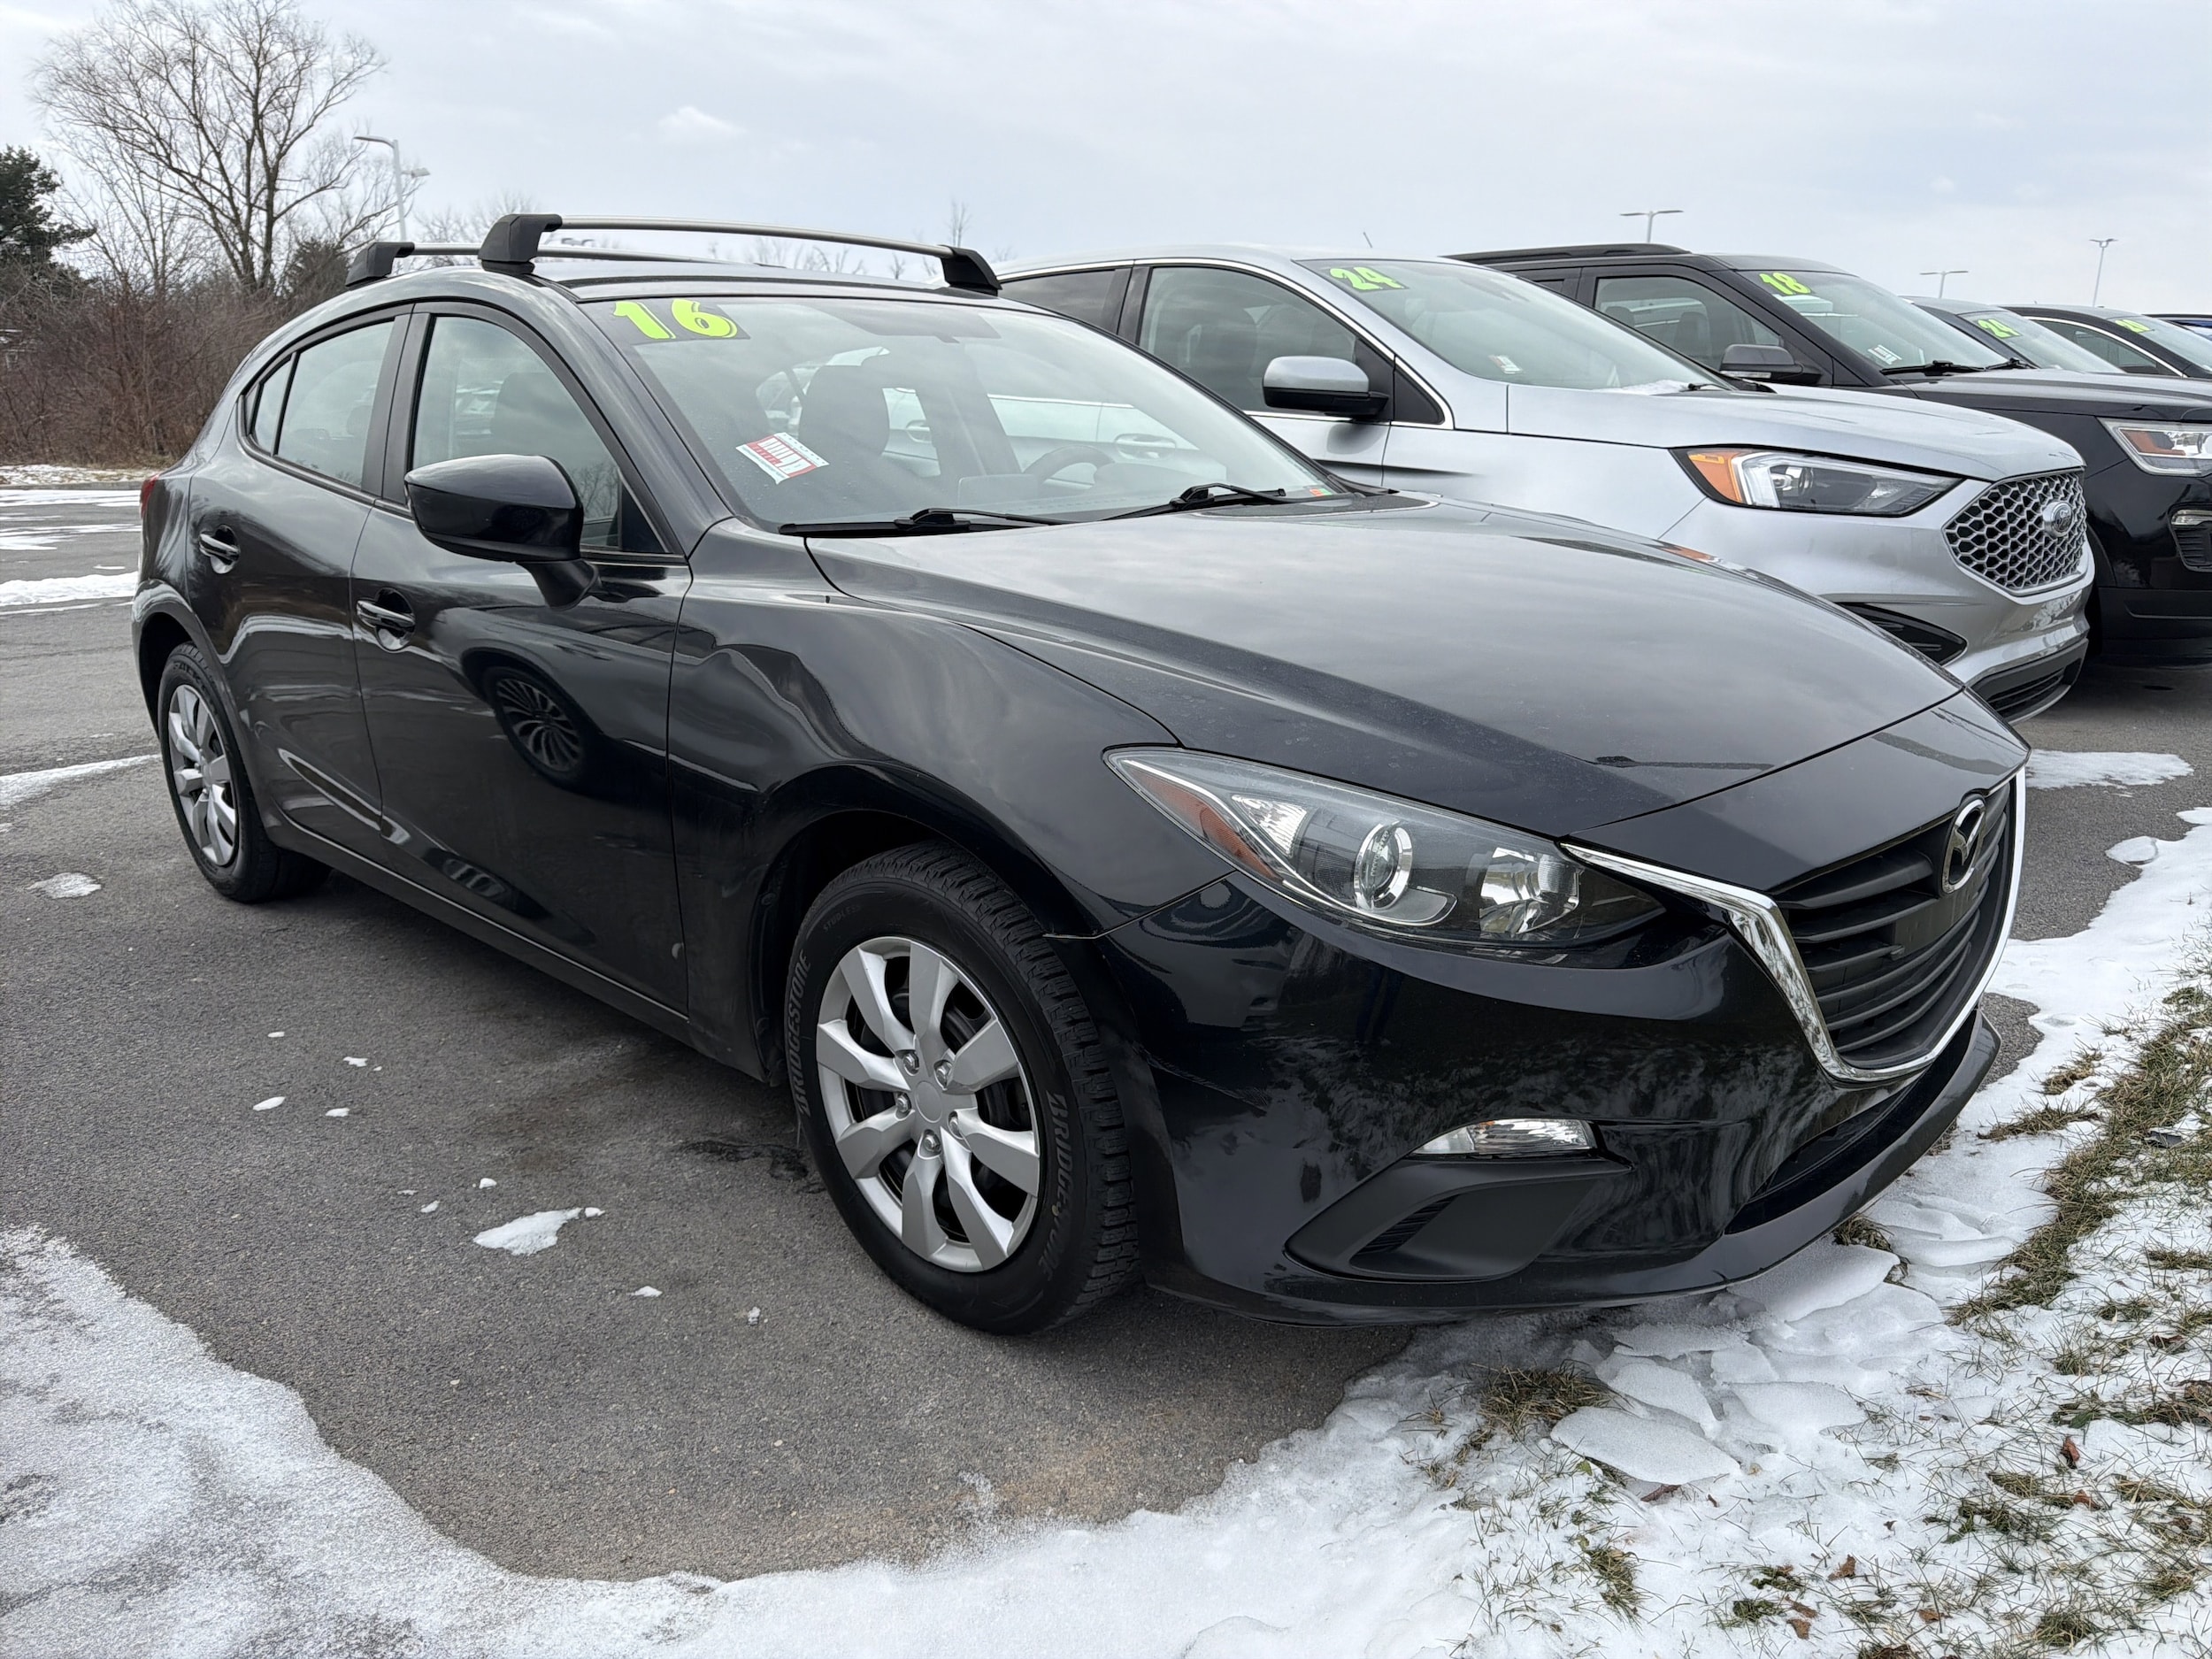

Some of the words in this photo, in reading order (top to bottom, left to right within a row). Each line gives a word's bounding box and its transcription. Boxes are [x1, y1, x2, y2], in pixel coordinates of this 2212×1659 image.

[1330, 267, 1404, 290] 24
[1759, 273, 1811, 295] 18
[613, 298, 738, 339] 16
[1978, 319, 2022, 338] 24
[787, 948, 812, 1118] BRIDGESTONE
